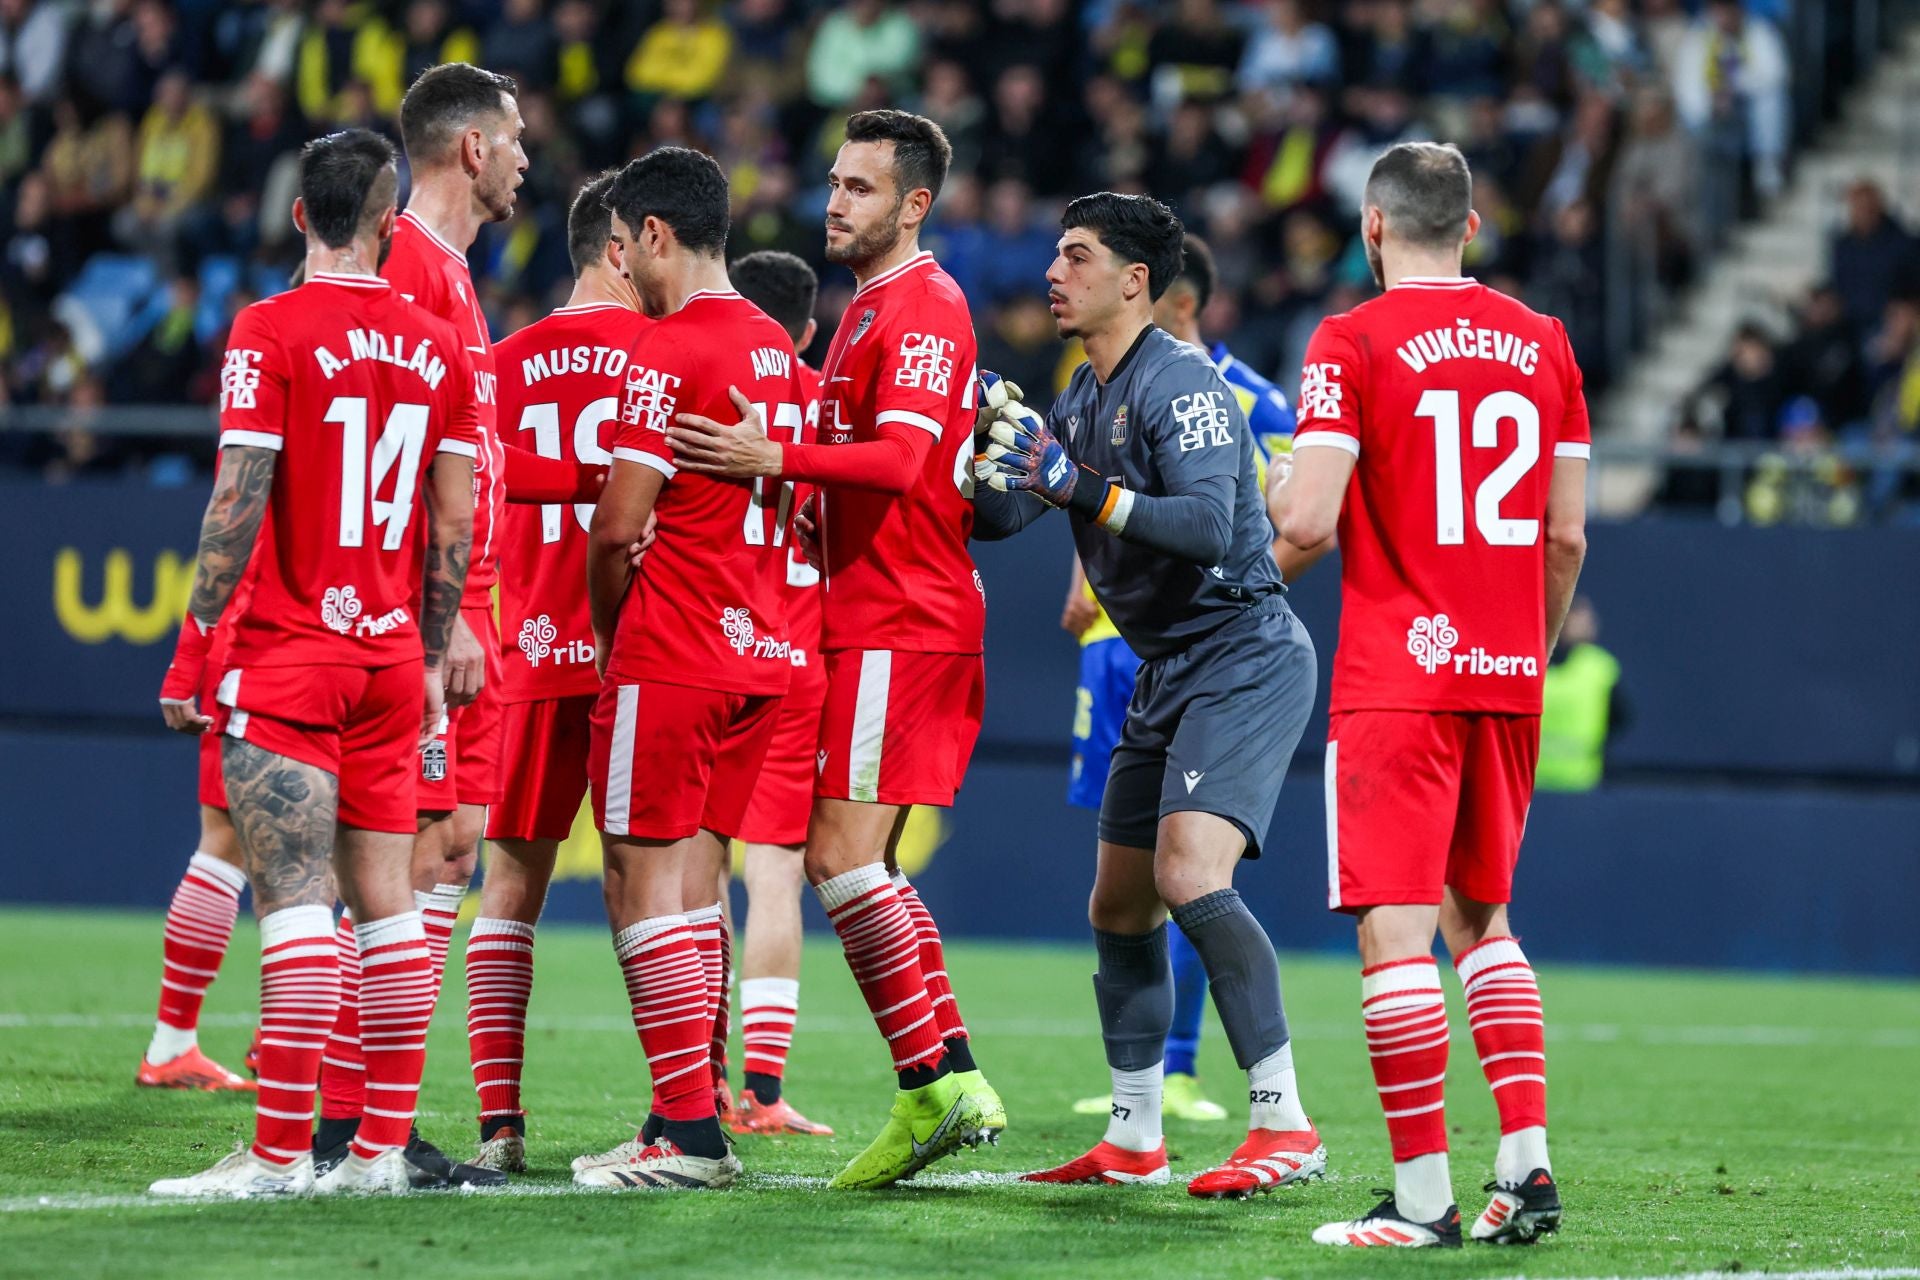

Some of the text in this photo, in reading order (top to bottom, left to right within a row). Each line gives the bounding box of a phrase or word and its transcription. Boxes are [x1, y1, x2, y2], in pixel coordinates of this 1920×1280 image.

[346, 328, 447, 391] MILLÁN
[522, 346, 628, 387] MUSTO
[750, 348, 790, 380] ANDY
[1396, 317, 1541, 376] VUKČEVIĆ
[323, 397, 430, 550] 14
[743, 402, 803, 547] 17
[1413, 390, 1541, 546] 12
[1453, 647, 1538, 677] ribera
